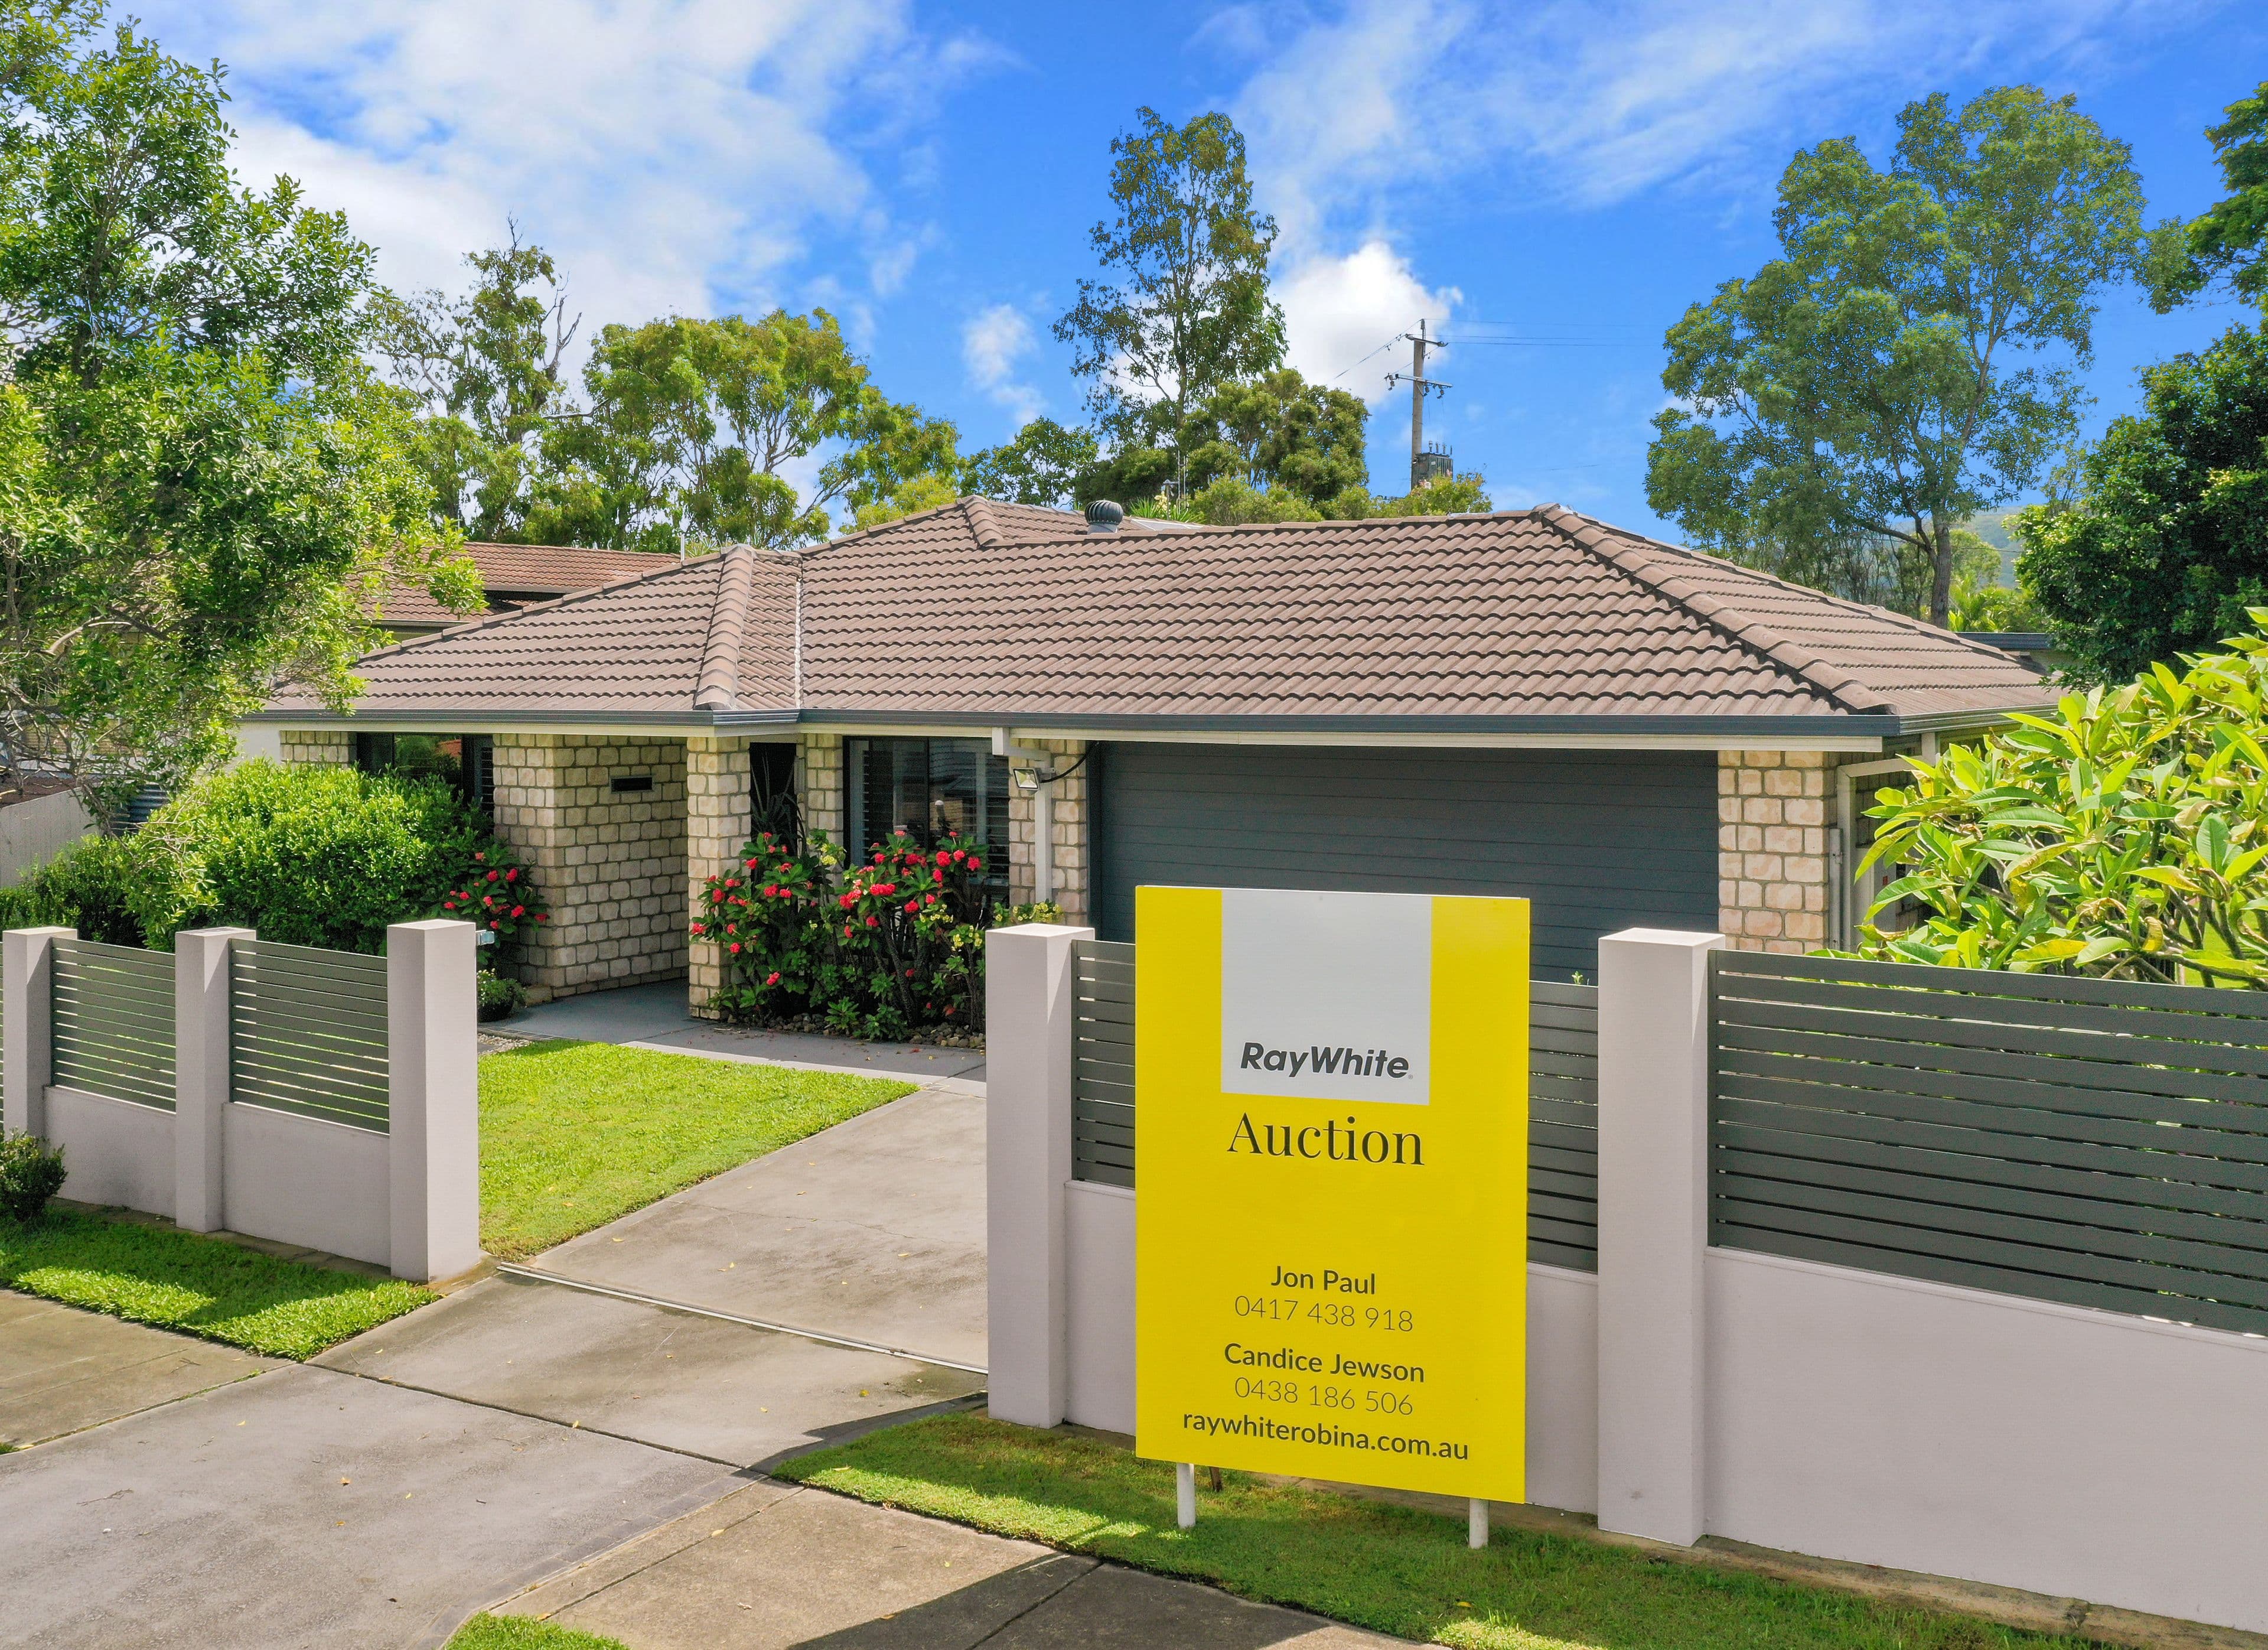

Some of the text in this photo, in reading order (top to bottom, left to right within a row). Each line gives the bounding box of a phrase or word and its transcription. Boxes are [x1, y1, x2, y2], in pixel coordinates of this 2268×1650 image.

[1227, 1112, 1425, 1166] Auction
[1270, 1265, 1376, 1295] Jon Paul
[1234, 1296, 1413, 1332] 0417 438 918
[1224, 1342, 1425, 1383] Candice Jewson
[1234, 1377, 1413, 1415] 0438 186 506
[1183, 1413, 1469, 1460] raywhiterobina.com.au
